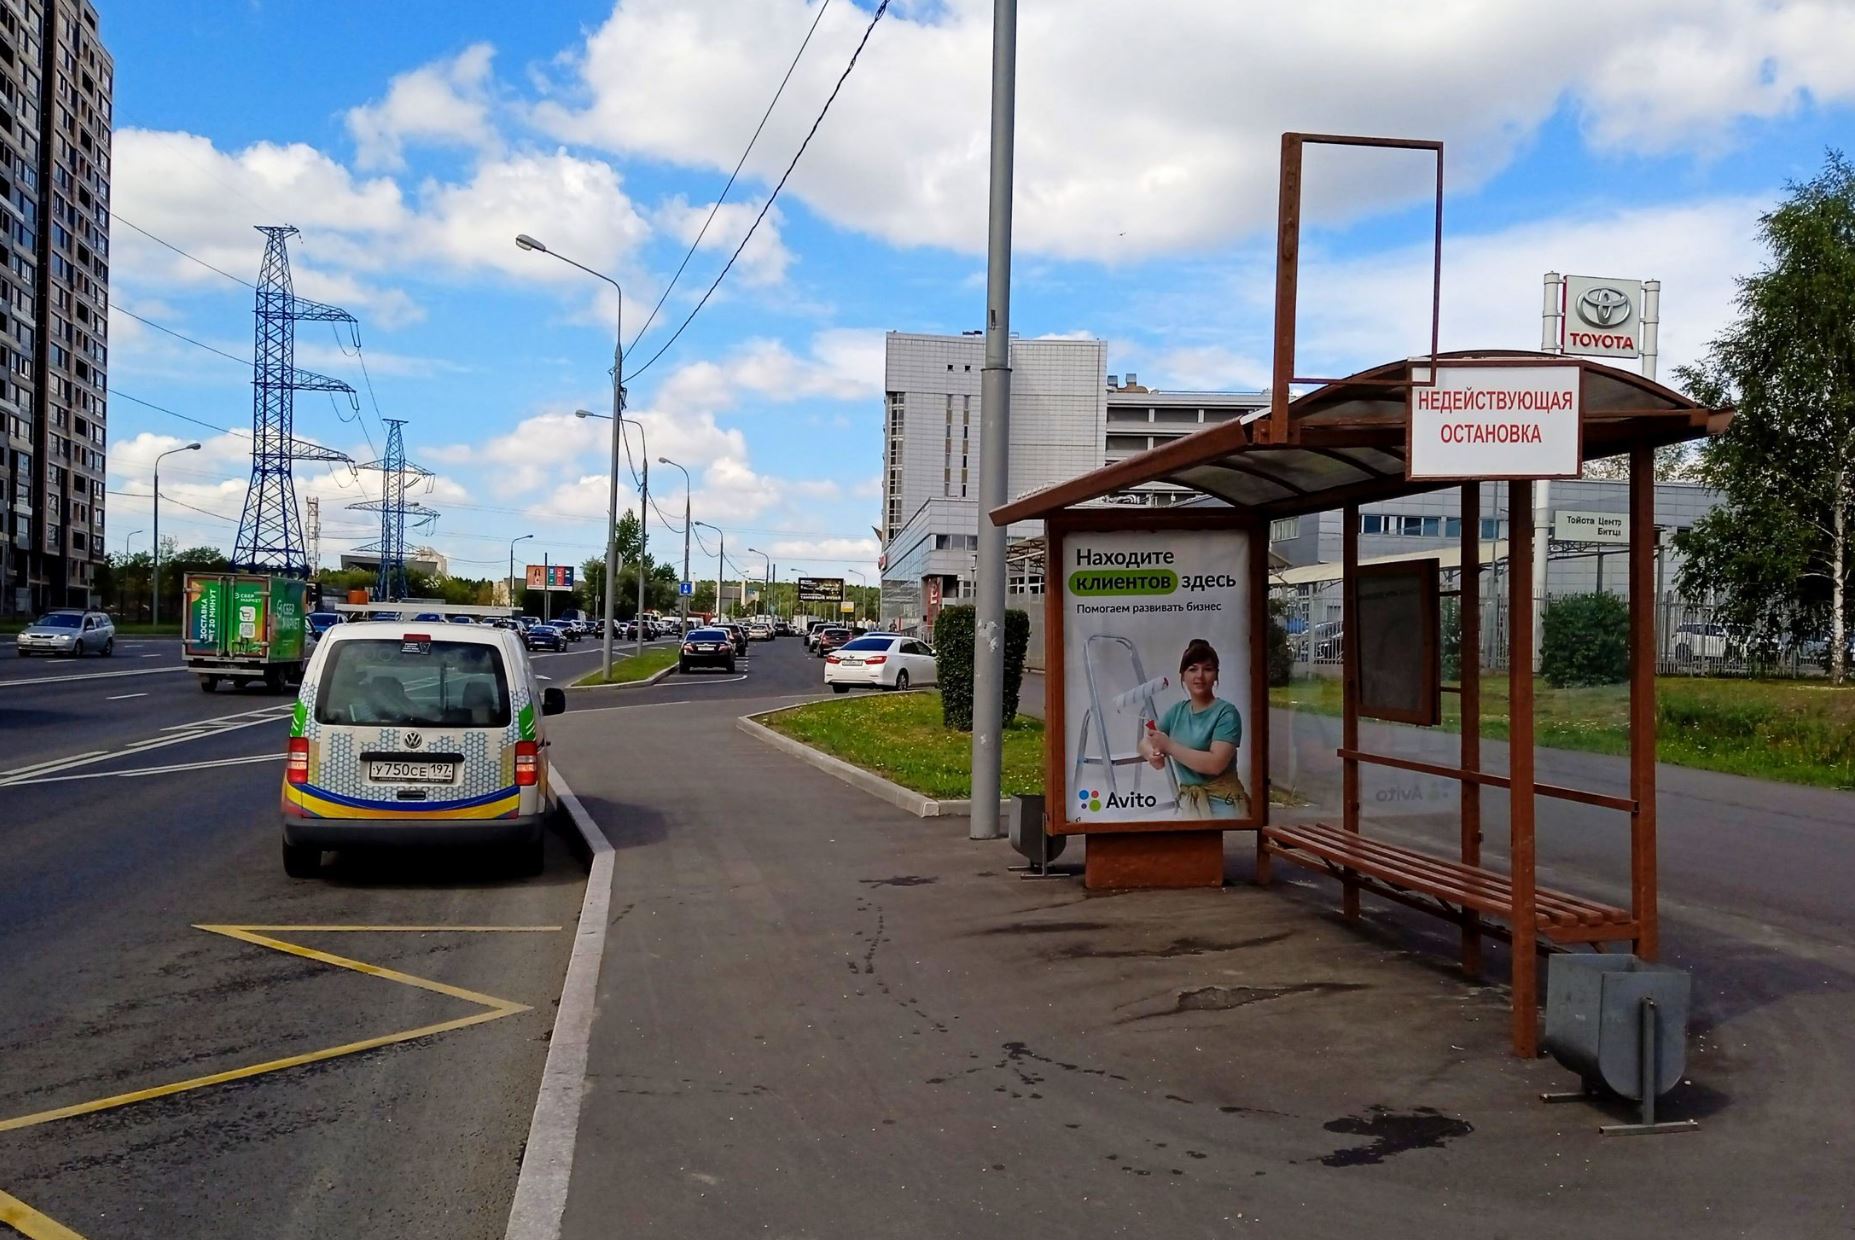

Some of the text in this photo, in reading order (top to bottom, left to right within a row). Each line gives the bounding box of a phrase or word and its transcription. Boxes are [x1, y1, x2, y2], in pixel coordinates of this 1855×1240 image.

[1569, 333, 1634, 350] TOYOTA
[1418, 387, 1573, 413] НЕДЕЙСТВУЮЩАЯ
[1440, 424, 1542, 443] ОСТАНОВКА
[1566, 515, 1595, 525] Тойота
[1076, 527, 1174, 568] Находите
[1076, 574, 1236, 591] клиентов здесь
[209, 589, 217, 618] МИНУТ
[1077, 602, 1222, 614] Помогаем развивать бизнес
[200, 598, 208, 640] ДОСТАВКА
[209, 619, 216, 628] 20
[375, 763, 450, 777] У750СЕ 197
[1106, 792, 1157, 808] Avito
